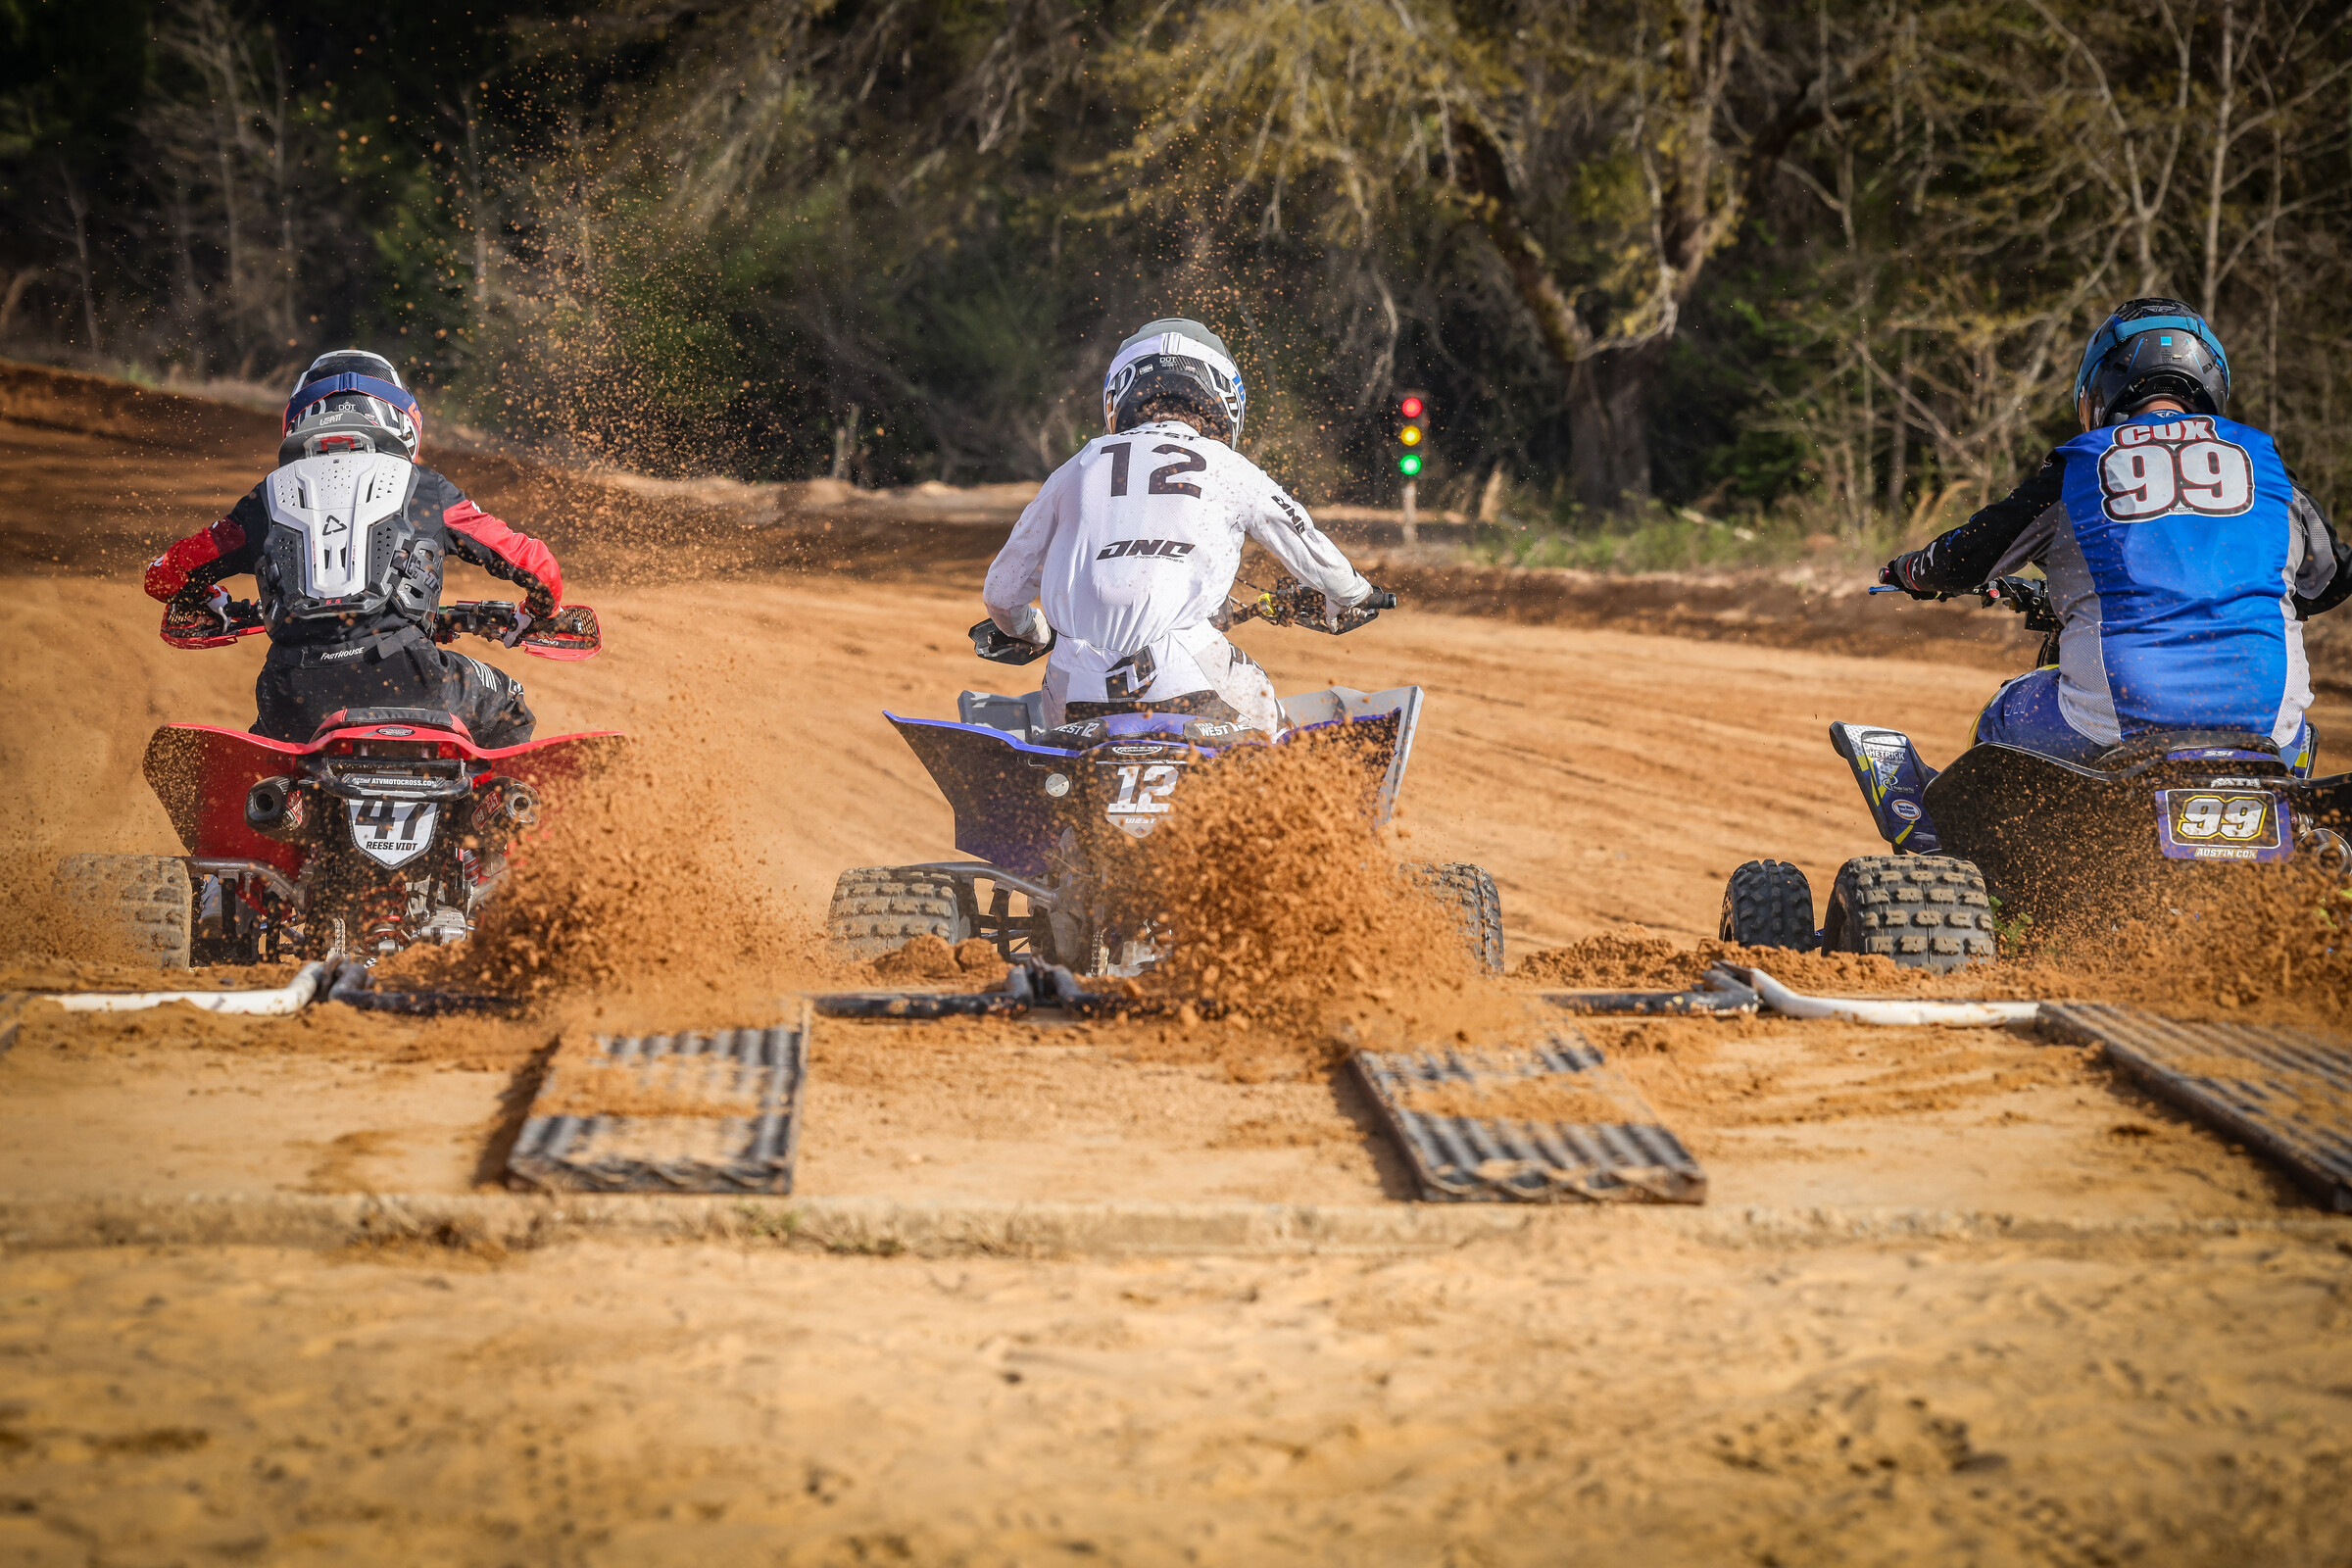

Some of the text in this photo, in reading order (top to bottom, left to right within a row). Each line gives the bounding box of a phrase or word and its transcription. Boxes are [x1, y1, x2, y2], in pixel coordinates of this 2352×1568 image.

[318, 413, 344, 426] LEATT
[338, 404, 356, 413] DOT
[2120, 419, 2214, 446] COX
[1100, 441, 1207, 500] 12
[2104, 441, 2249, 516] 99
[1911, 541, 1937, 581] FLY
[320, 646, 365, 661] FASTHOUSE
[1869, 749, 1905, 760] HETRICK
[1107, 765, 1179, 813] 12
[355, 800, 431, 841] 47
[2178, 795, 2268, 841] 99
[366, 841, 394, 851] REESE
[2195, 848, 2235, 858] AUSTIN
